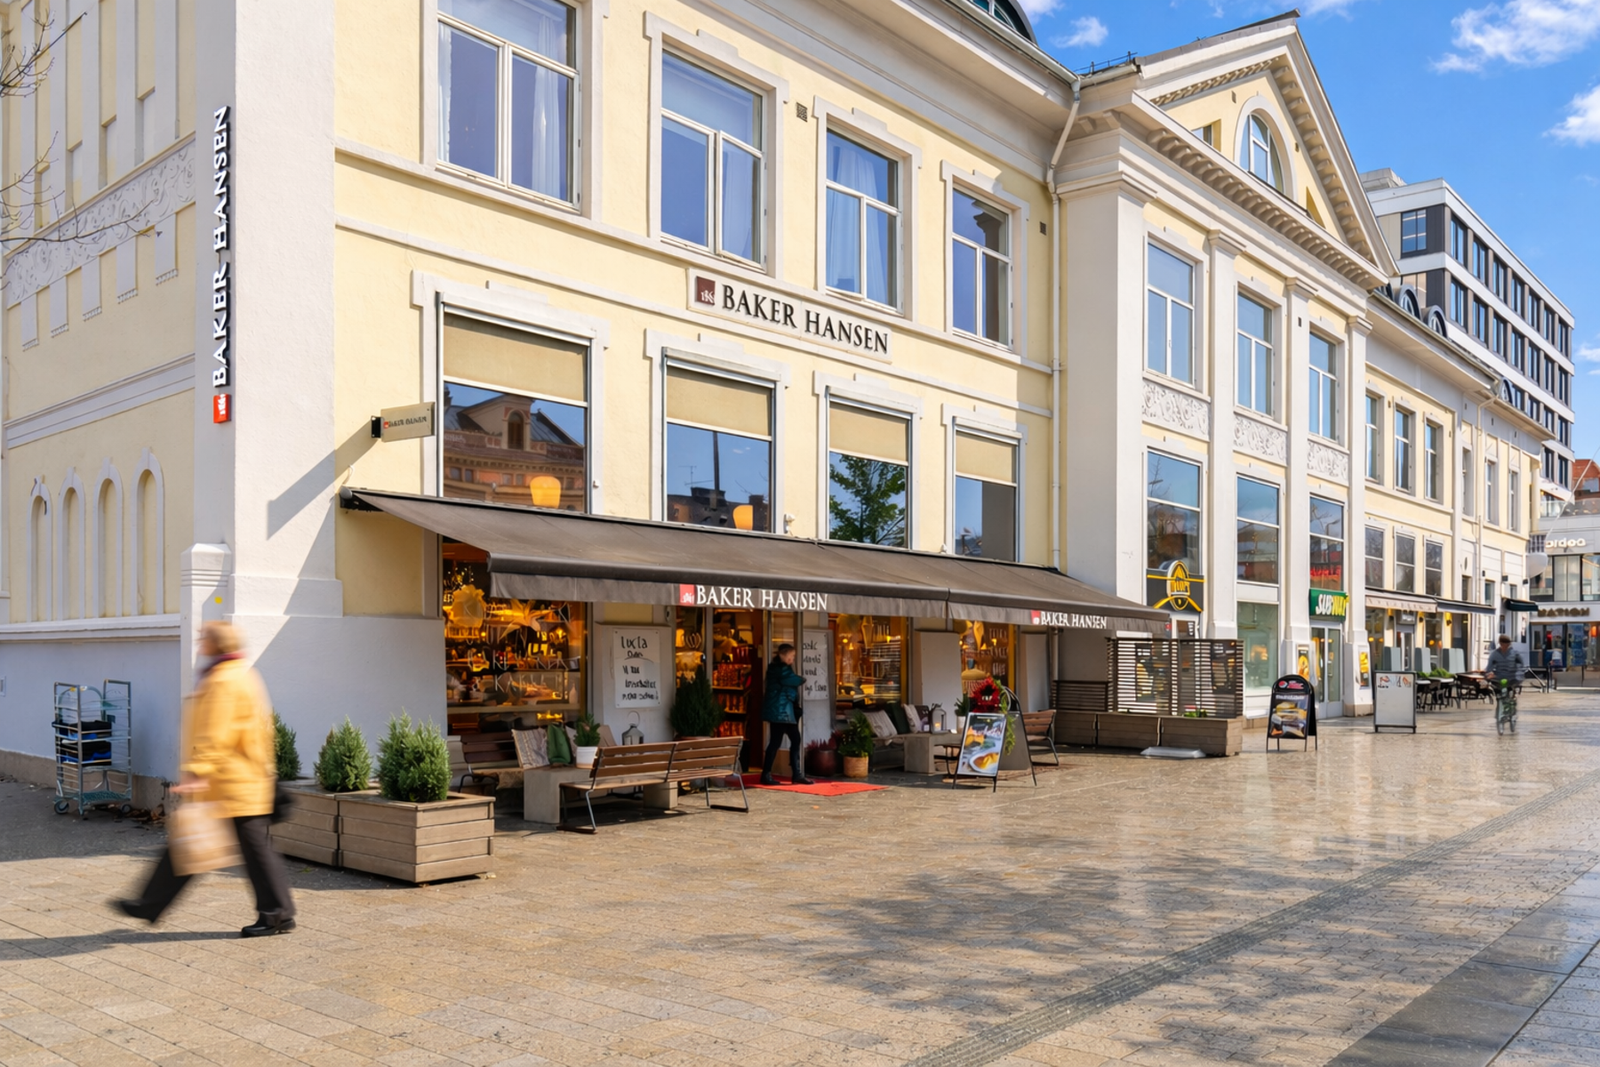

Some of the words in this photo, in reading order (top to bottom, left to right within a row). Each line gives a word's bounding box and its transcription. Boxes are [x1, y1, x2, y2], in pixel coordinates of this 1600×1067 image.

[213, 106, 229, 251] HANSEN
[213, 262, 228, 388] BAKER
[722, 284, 798, 329] BAKER
[805, 309, 889, 354] HANSEN
[696, 585, 755, 608] BAKER
[761, 589, 828, 611] HANSEN
[1041, 611, 1070, 627] BAKER
[1071, 613, 1107, 629] HANSEN
